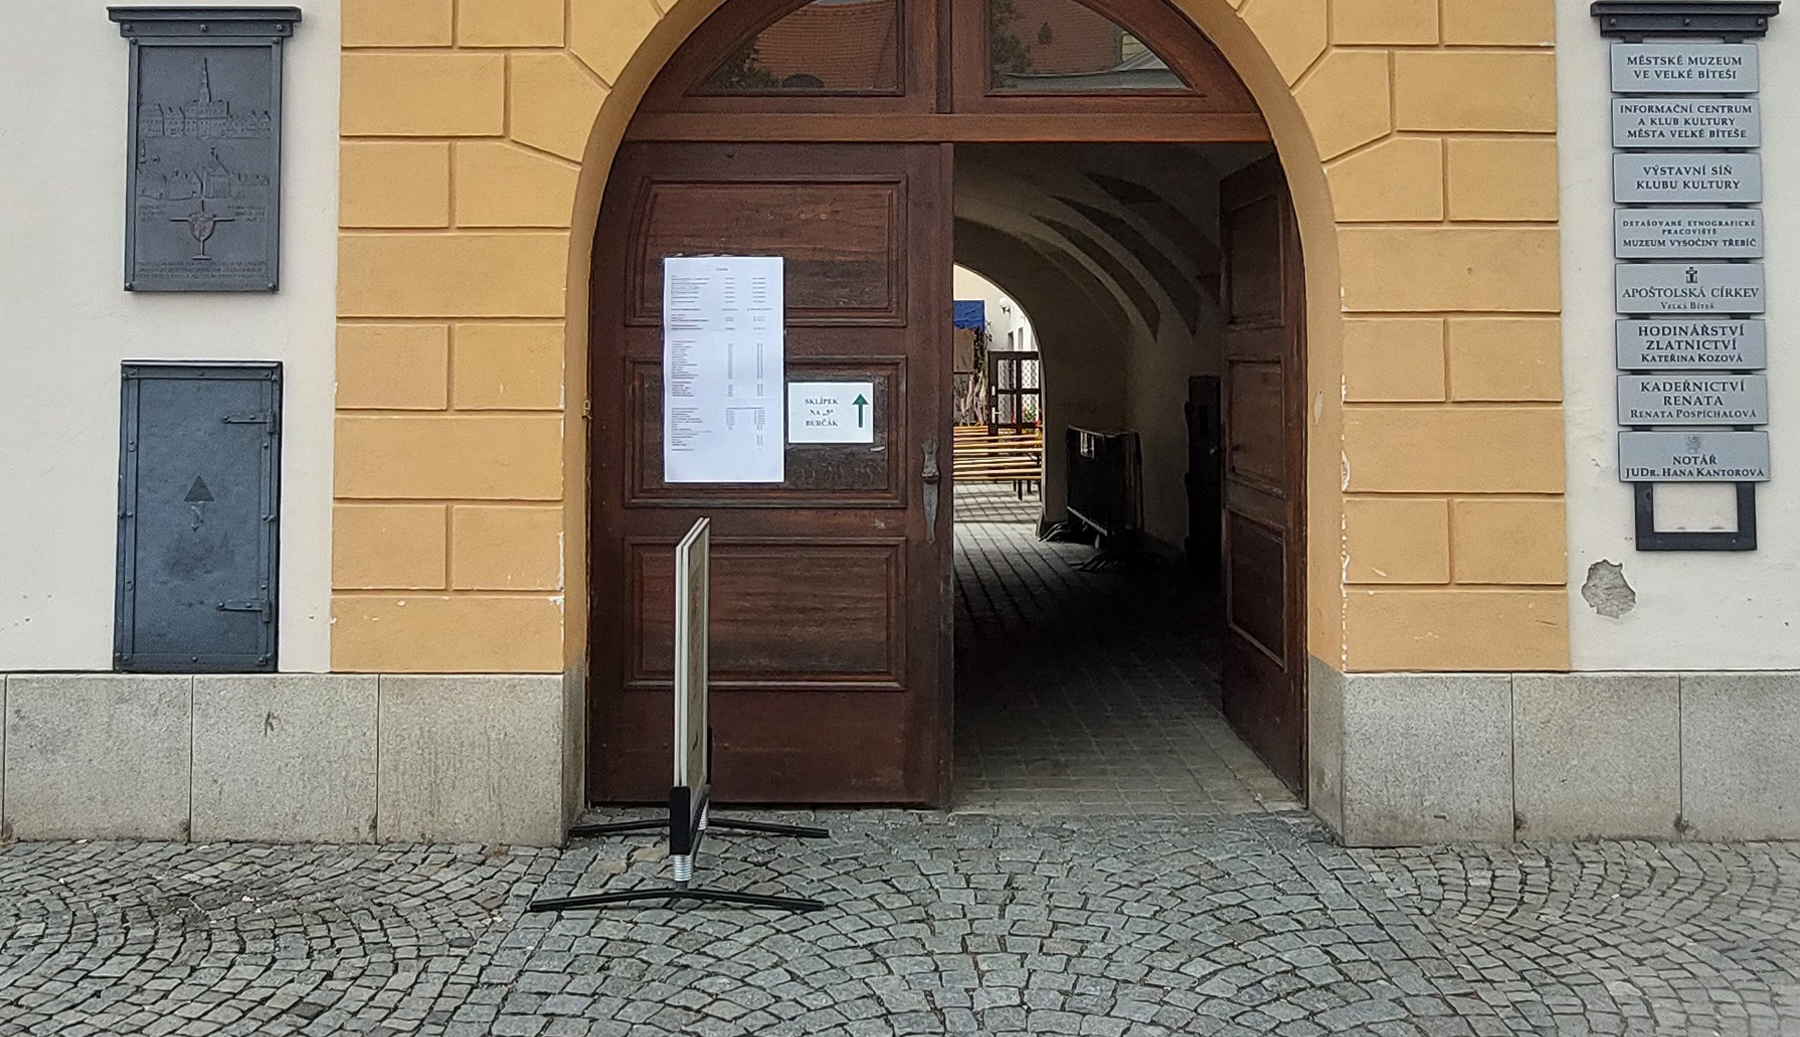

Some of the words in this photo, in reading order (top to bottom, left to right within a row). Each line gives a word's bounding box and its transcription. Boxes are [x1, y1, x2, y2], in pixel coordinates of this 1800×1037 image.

[1627, 55, 1683, 65] MĚSTSKÉ
[1688, 57, 1742, 65] MUZEUM
[1634, 70, 1649, 79] VE
[1655, 69, 1693, 79] VELKÉ
[1698, 69, 1736, 79] BÍTEŠI
[1620, 104, 1693, 113] INFORMAČNÍ
[1697, 105, 1752, 113] CENTRUM
[1628, 129, 1665, 138] MĚSTA
[1670, 129, 1705, 138] VELKÉ
[1709, 129, 1746, 138] BÍTEŠE
[1643, 165, 1706, 175] VÝSTAVNÍ
[1711, 165, 1732, 175] SÍŇ
[1636, 180, 1678, 189] KLUBU
[1682, 180, 1740, 189] KULTURY
[1623, 239, 1666, 247] MUZEUM
[1670, 239, 1718, 247] VYSOČINY
[1723, 239, 1756, 247] TŘEBÍČ
[1623, 286, 1706, 298] APOŠTOLSKÁ
[1711, 287, 1759, 298] CÍRKEV
[1638, 324, 1745, 336] HODINÁŘSTVÍ
[1646, 338, 1736, 350] ZLATNICTVÍ
[1640, 379, 1745, 392] KADEŘNICTVÍ
[805, 397, 839, 405] SKLÍPEK
[1663, 396, 1724, 405] RENATA
[805, 419, 839, 427] BURČÁK
[1672, 454, 1717, 465] NOTÁŘ
